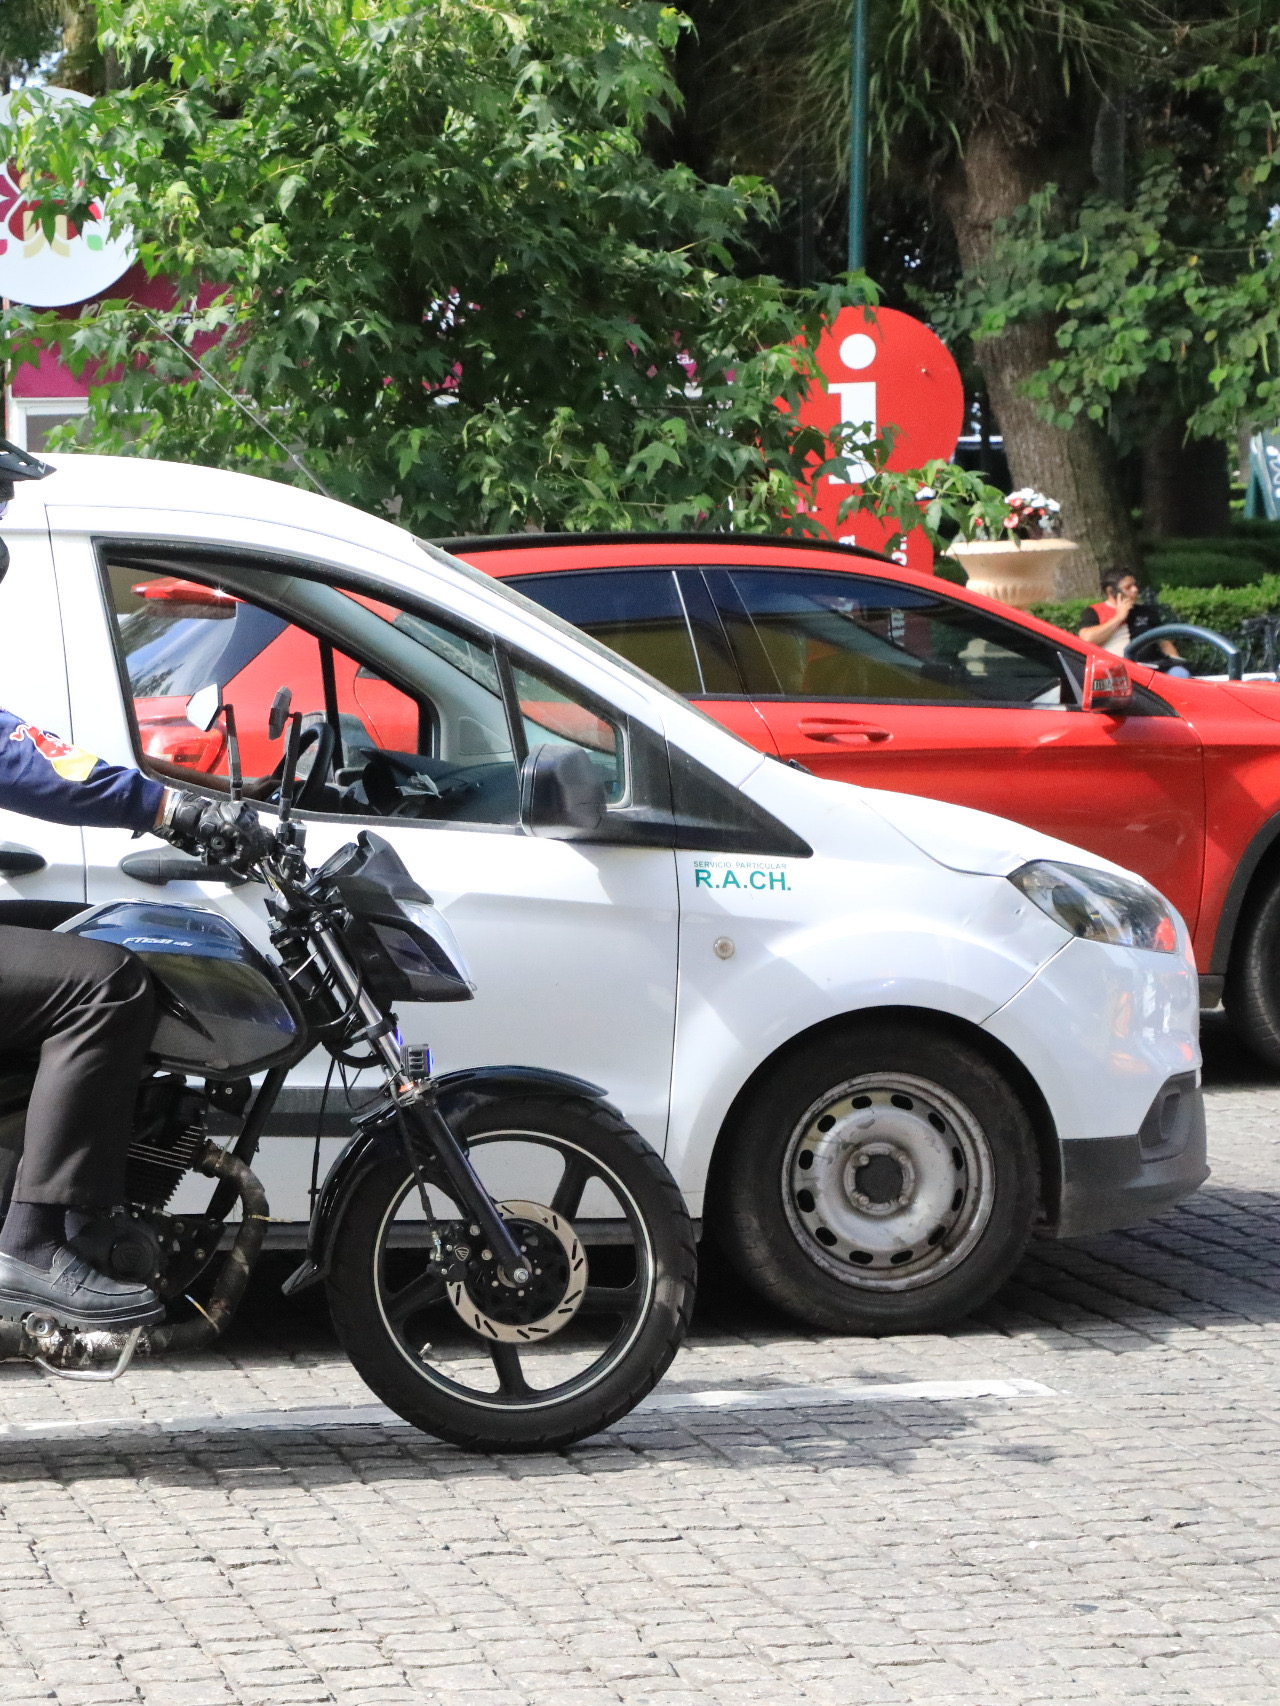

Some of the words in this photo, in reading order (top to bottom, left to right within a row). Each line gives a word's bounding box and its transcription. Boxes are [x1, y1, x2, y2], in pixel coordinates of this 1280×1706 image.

[693, 860, 732, 869] SERVICIO
[735, 861, 788, 870] PARTICULAR
[694, 868, 792, 891] R.A.CH.
